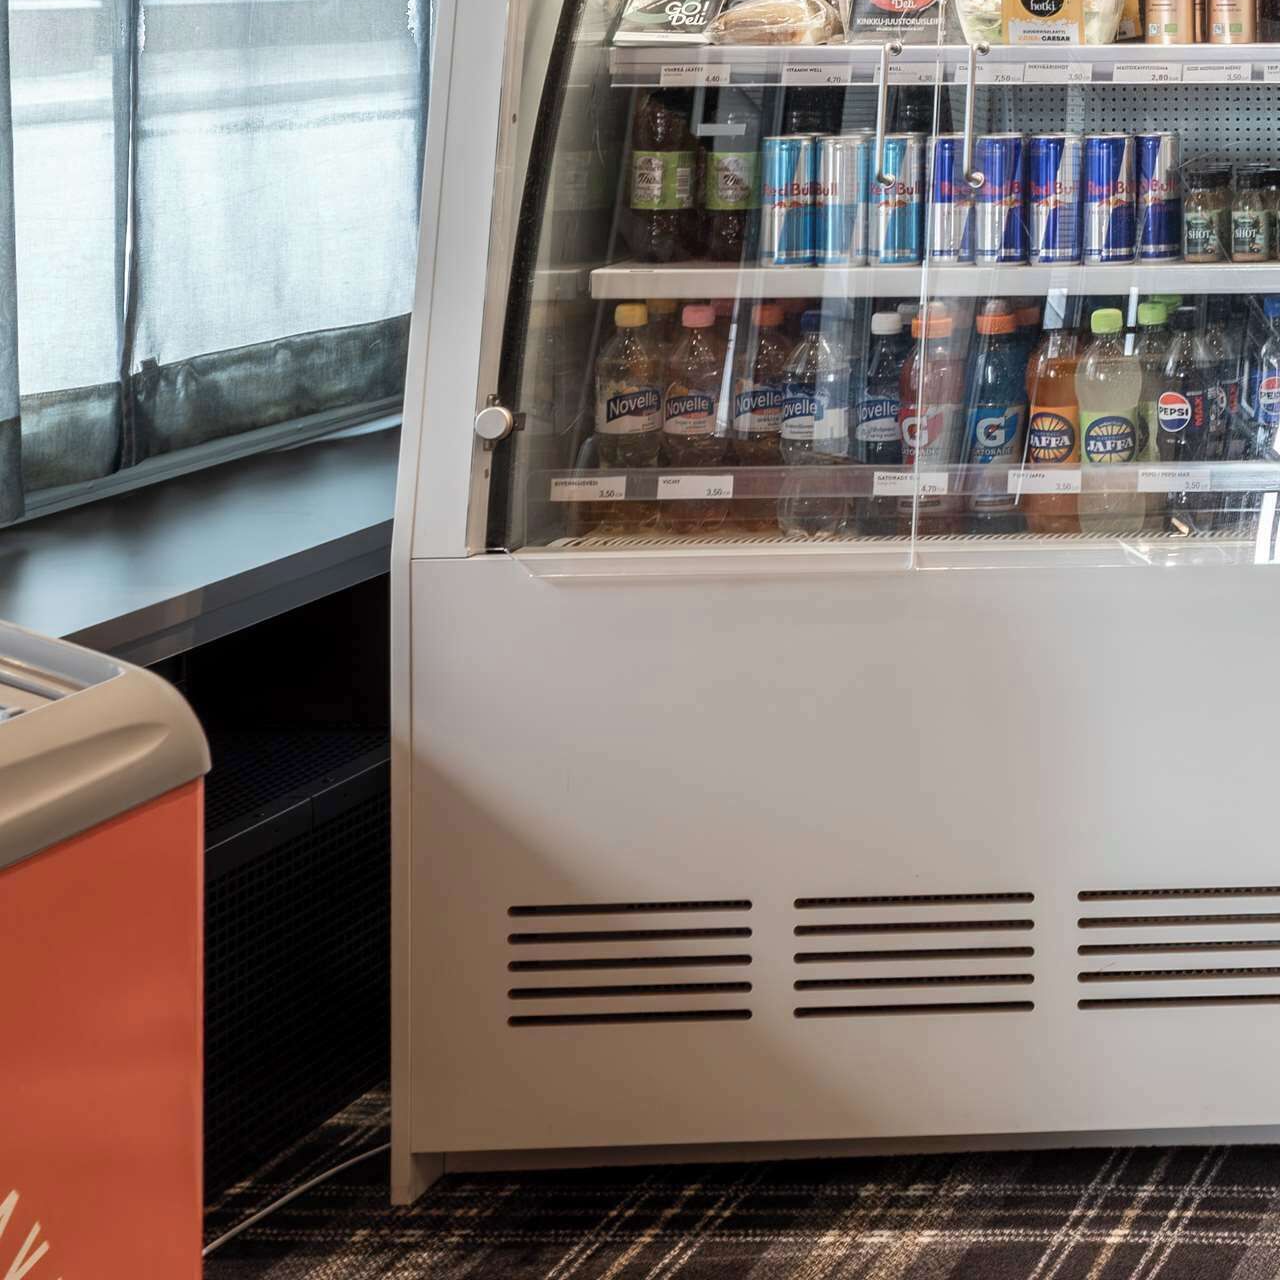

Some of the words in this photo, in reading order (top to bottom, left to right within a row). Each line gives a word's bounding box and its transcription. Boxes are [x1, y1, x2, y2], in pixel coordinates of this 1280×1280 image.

[665, 1, 710, 15] GO!
[892, 0, 916, 9] Deli
[668, 13, 707, 26] Deli
[1188, 228, 1211, 239] SHOT
[1234, 227, 1257, 239] SHOT
[609, 392, 659, 418] Novelle
[666, 396, 710, 416] Novelle
[736, 391, 781, 412] Novelle
[784, 399, 818, 417] ovelle
[1159, 406, 1190, 417] PEPSI
[1030, 435, 1071, 448] JAFFA
[1086, 438, 1133, 452] JAFFA
